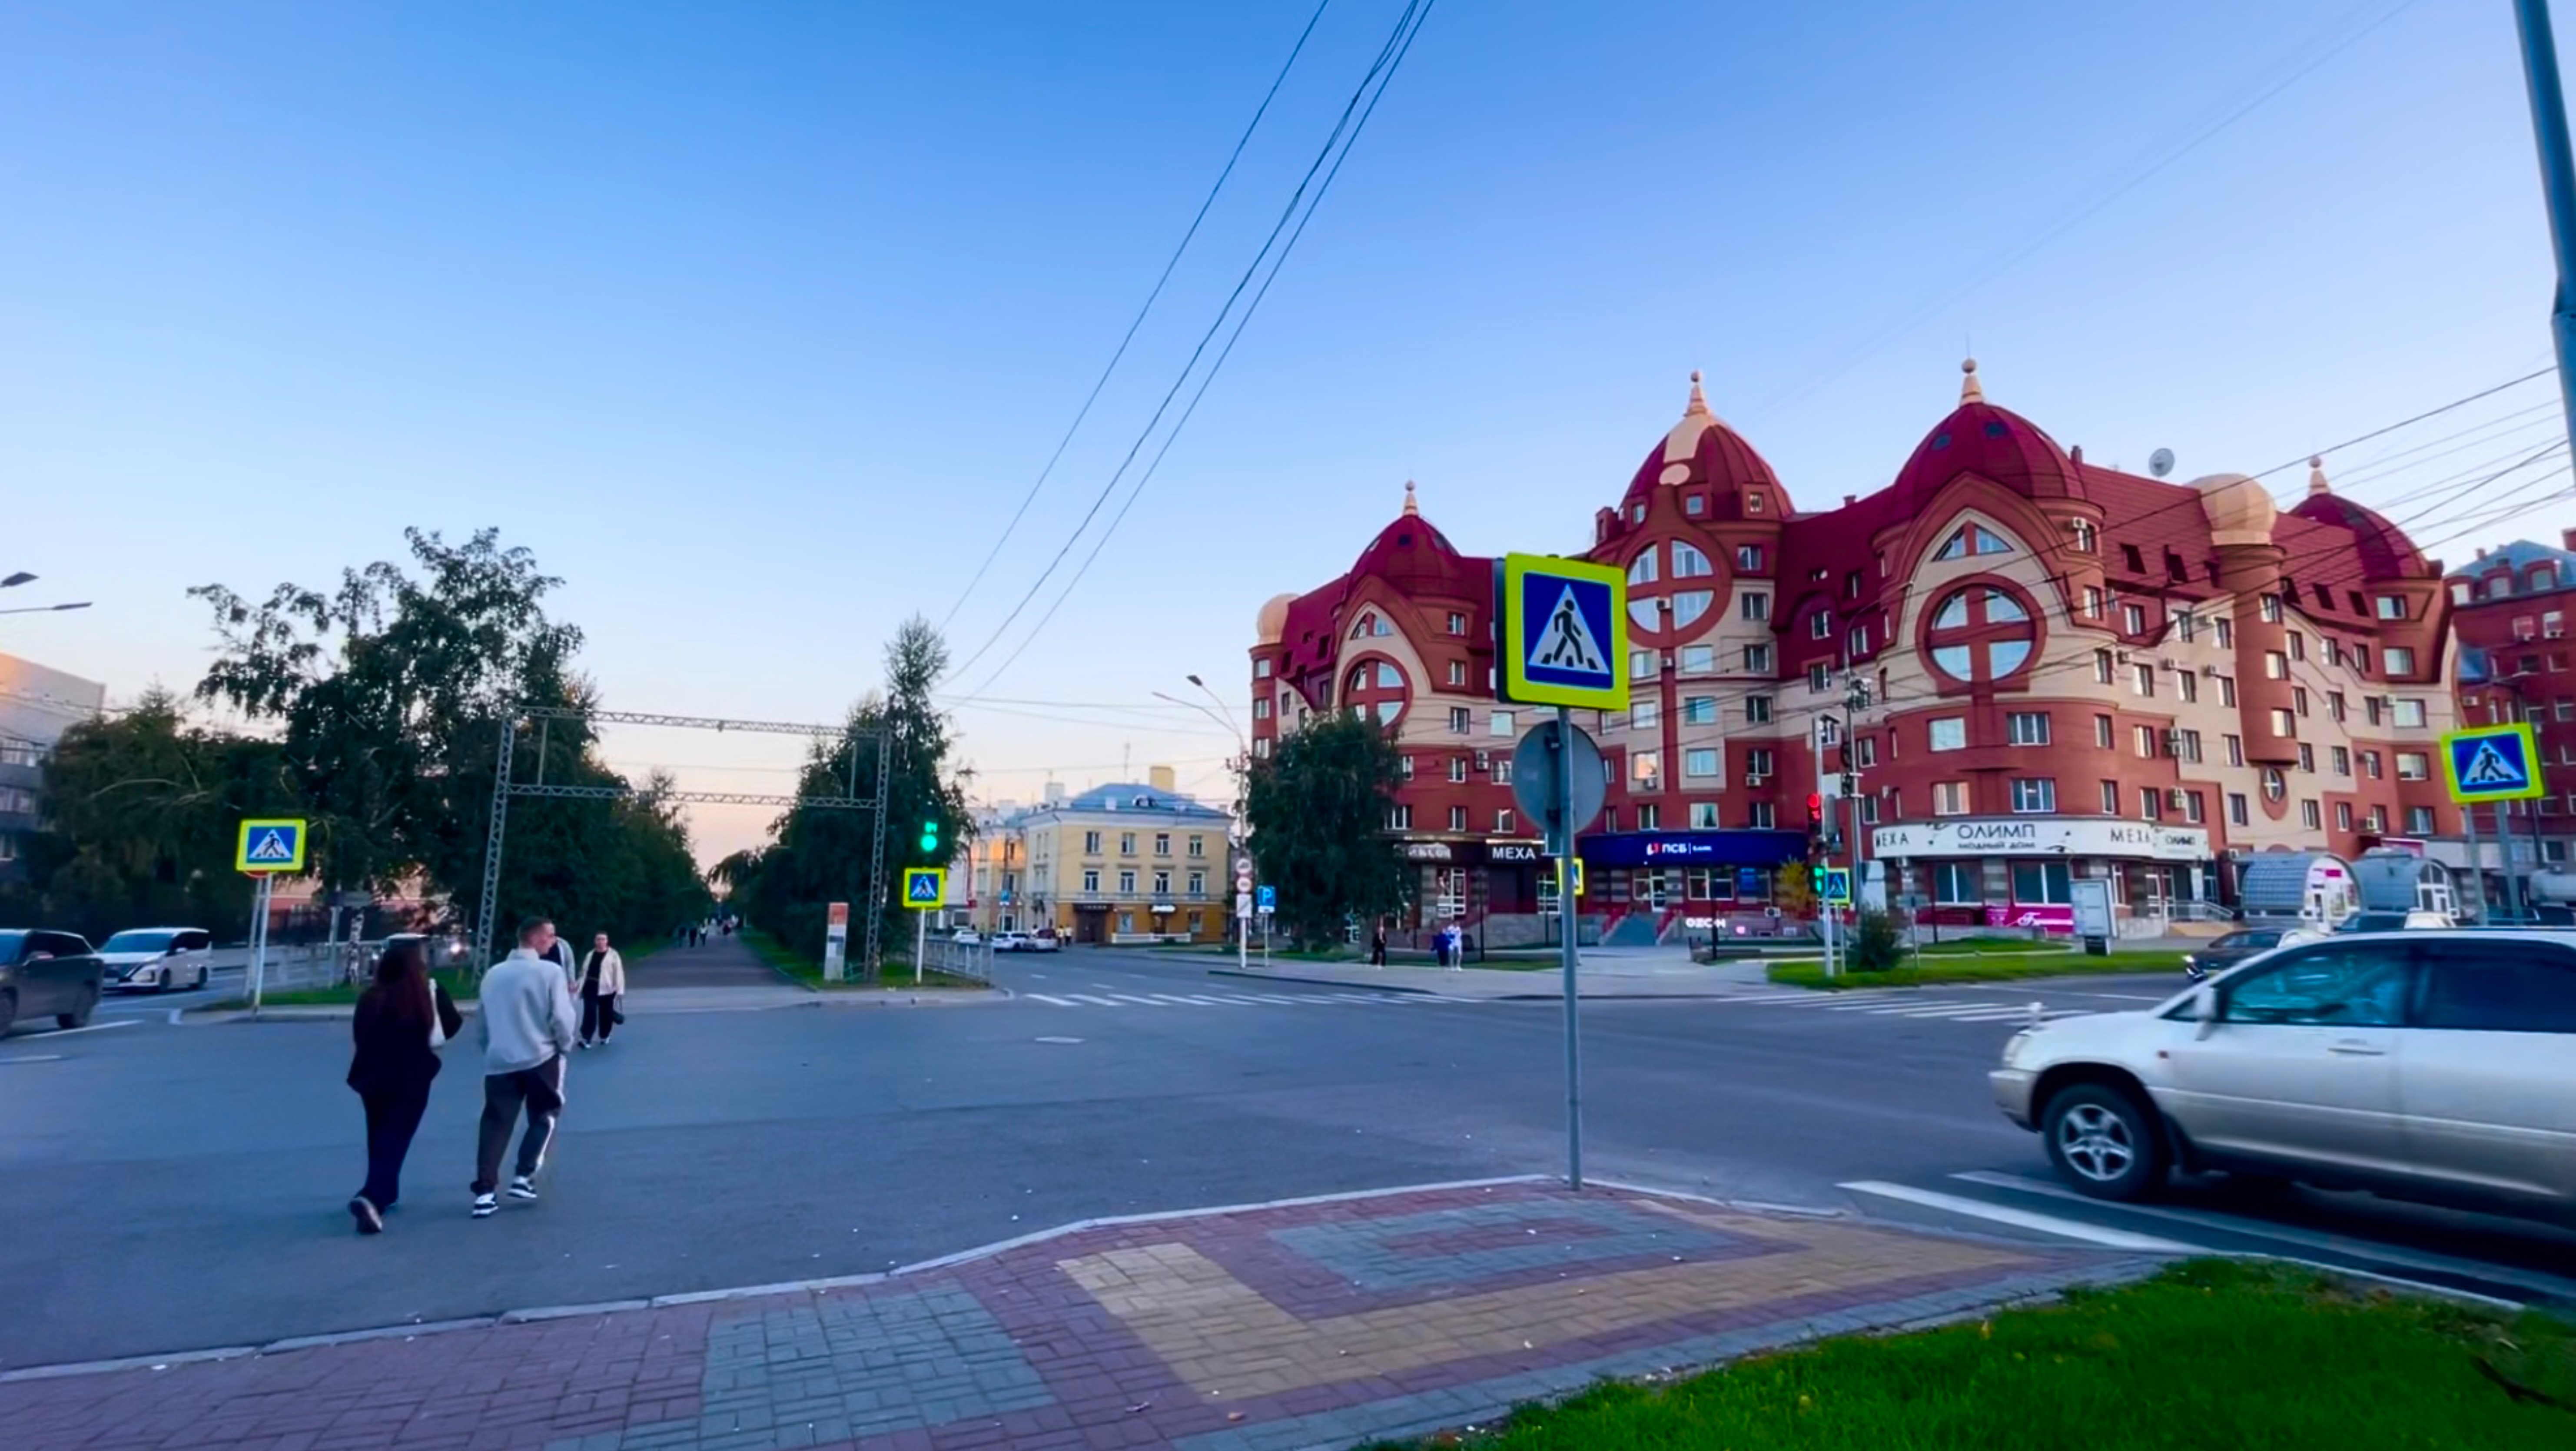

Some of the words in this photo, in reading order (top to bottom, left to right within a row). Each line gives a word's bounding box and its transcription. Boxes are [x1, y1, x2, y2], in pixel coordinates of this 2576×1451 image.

[1957, 824, 2035, 839] ОЛИМП
[1492, 847, 1536, 860] МЕХА
[1662, 843, 1687, 854] ПСБ
[1262, 887, 1271, 903] P
